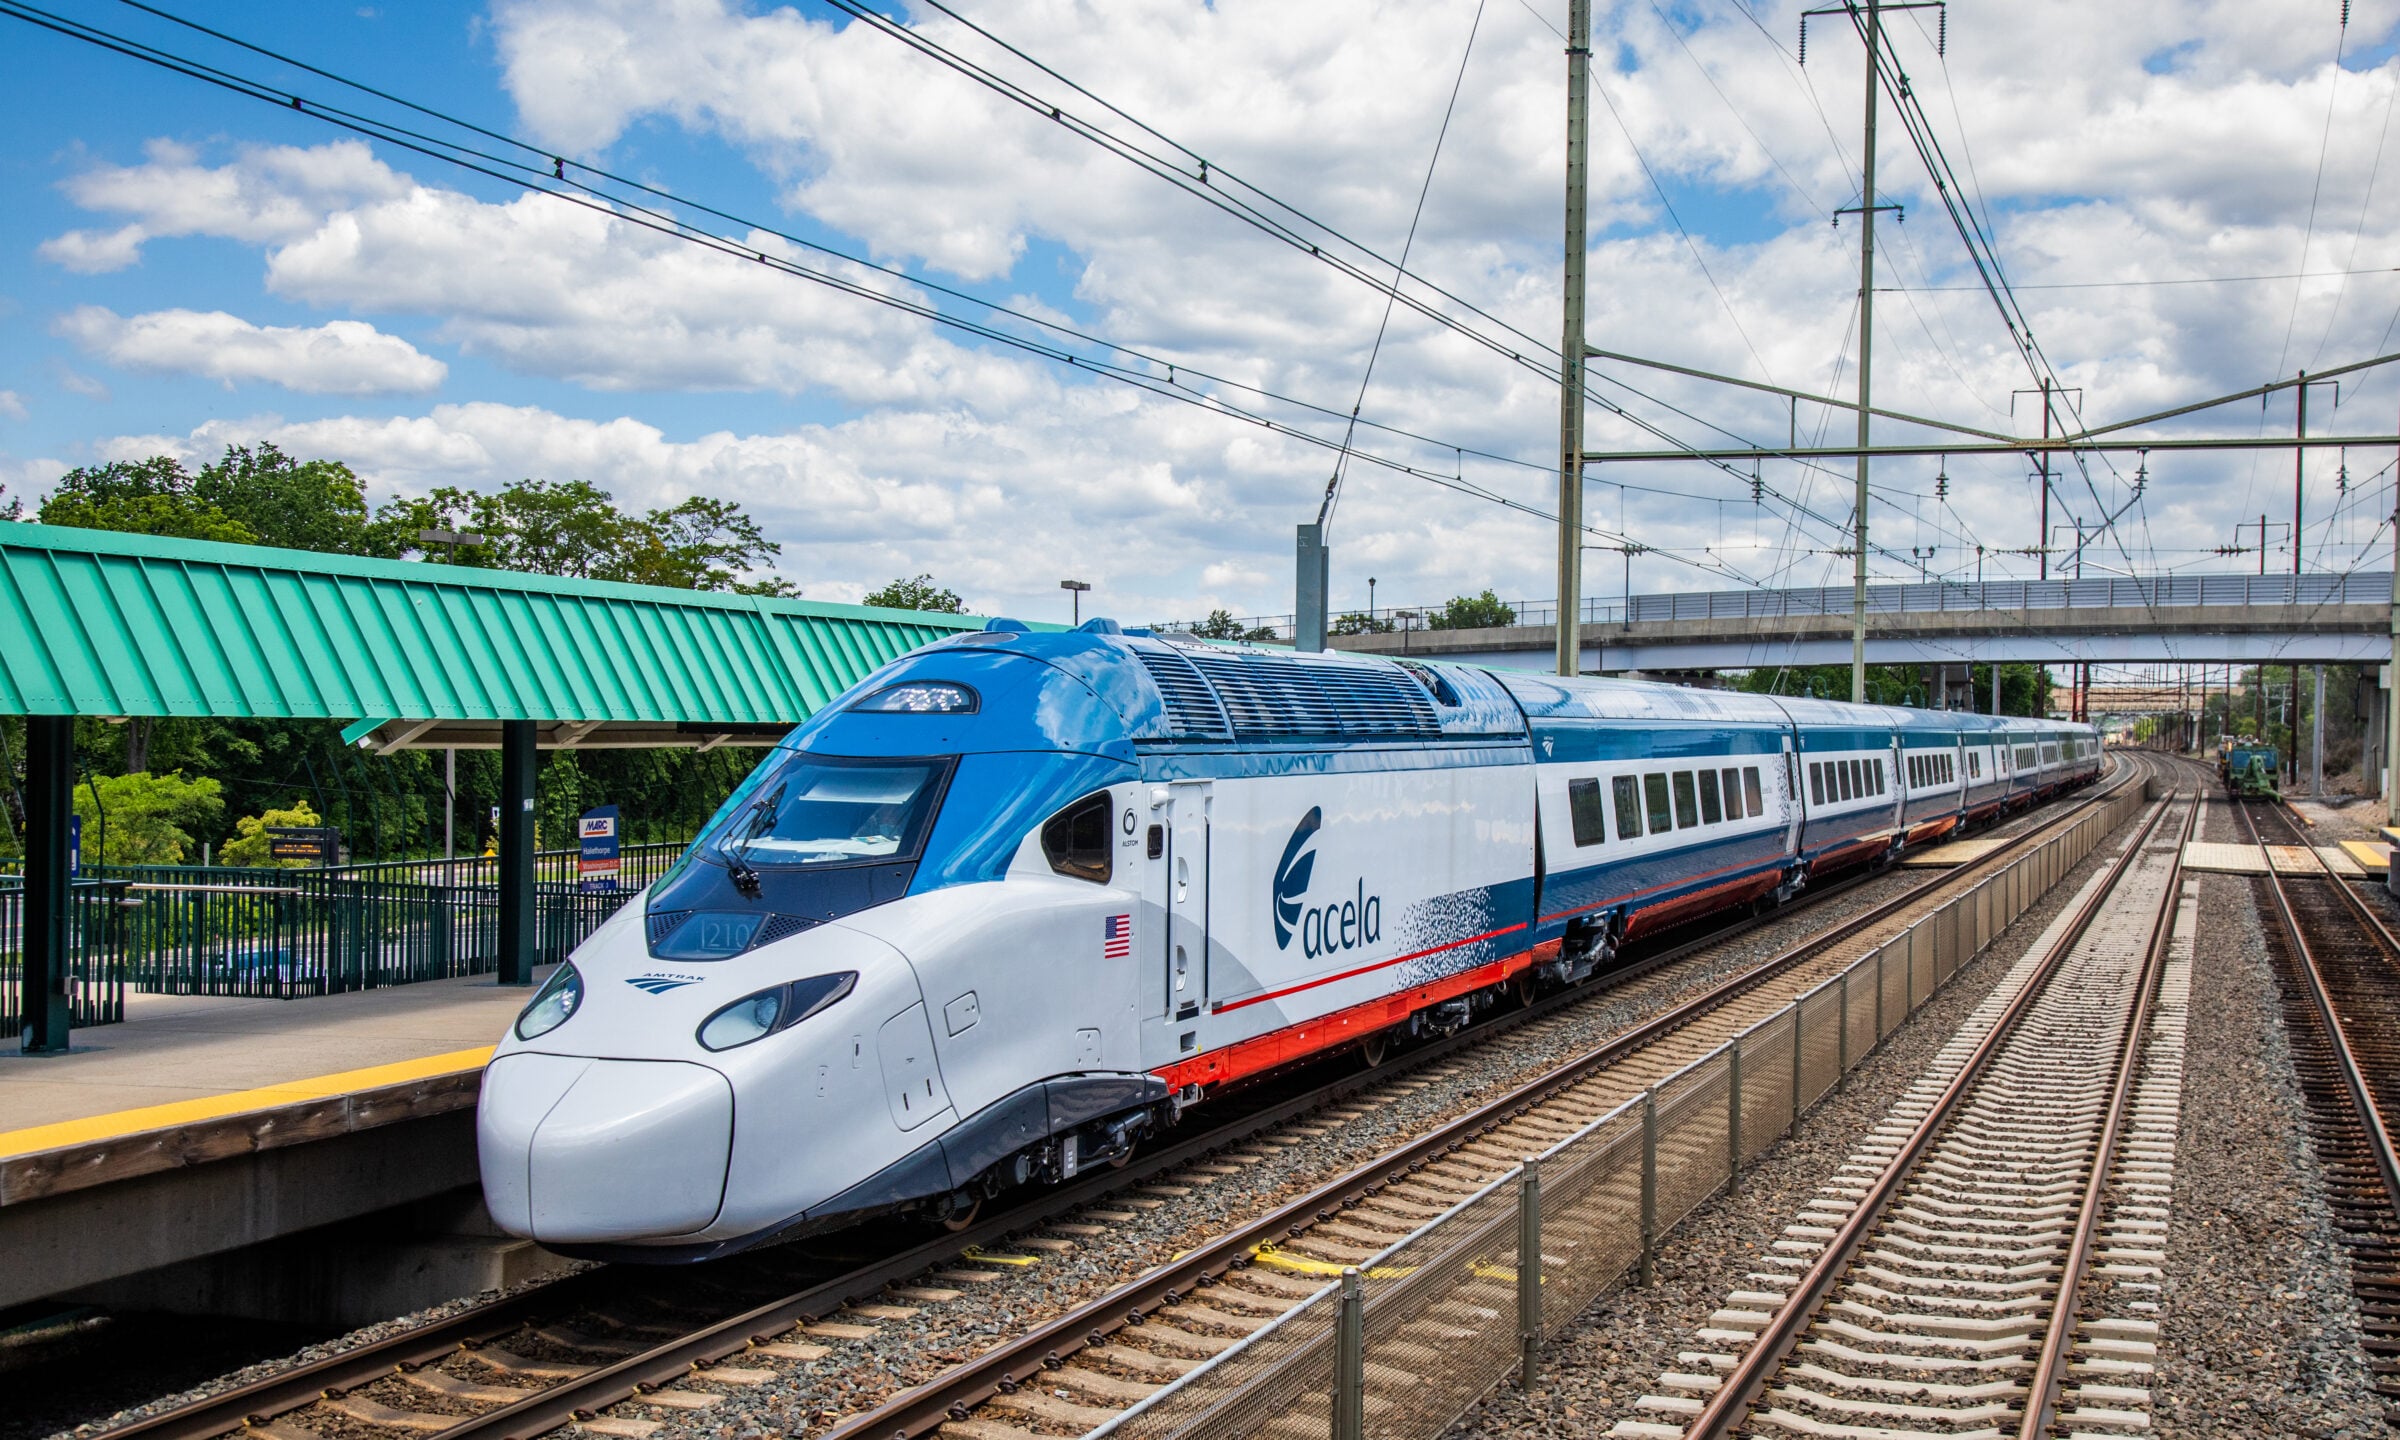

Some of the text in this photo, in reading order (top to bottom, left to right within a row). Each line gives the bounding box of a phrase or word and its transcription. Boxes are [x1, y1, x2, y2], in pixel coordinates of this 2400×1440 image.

[586, 820, 607, 831] MARC
[1122, 839, 1139, 847] ALSTOM
[1303, 876, 1381, 960] acela
[643, 972, 706, 981] AMTRAK
